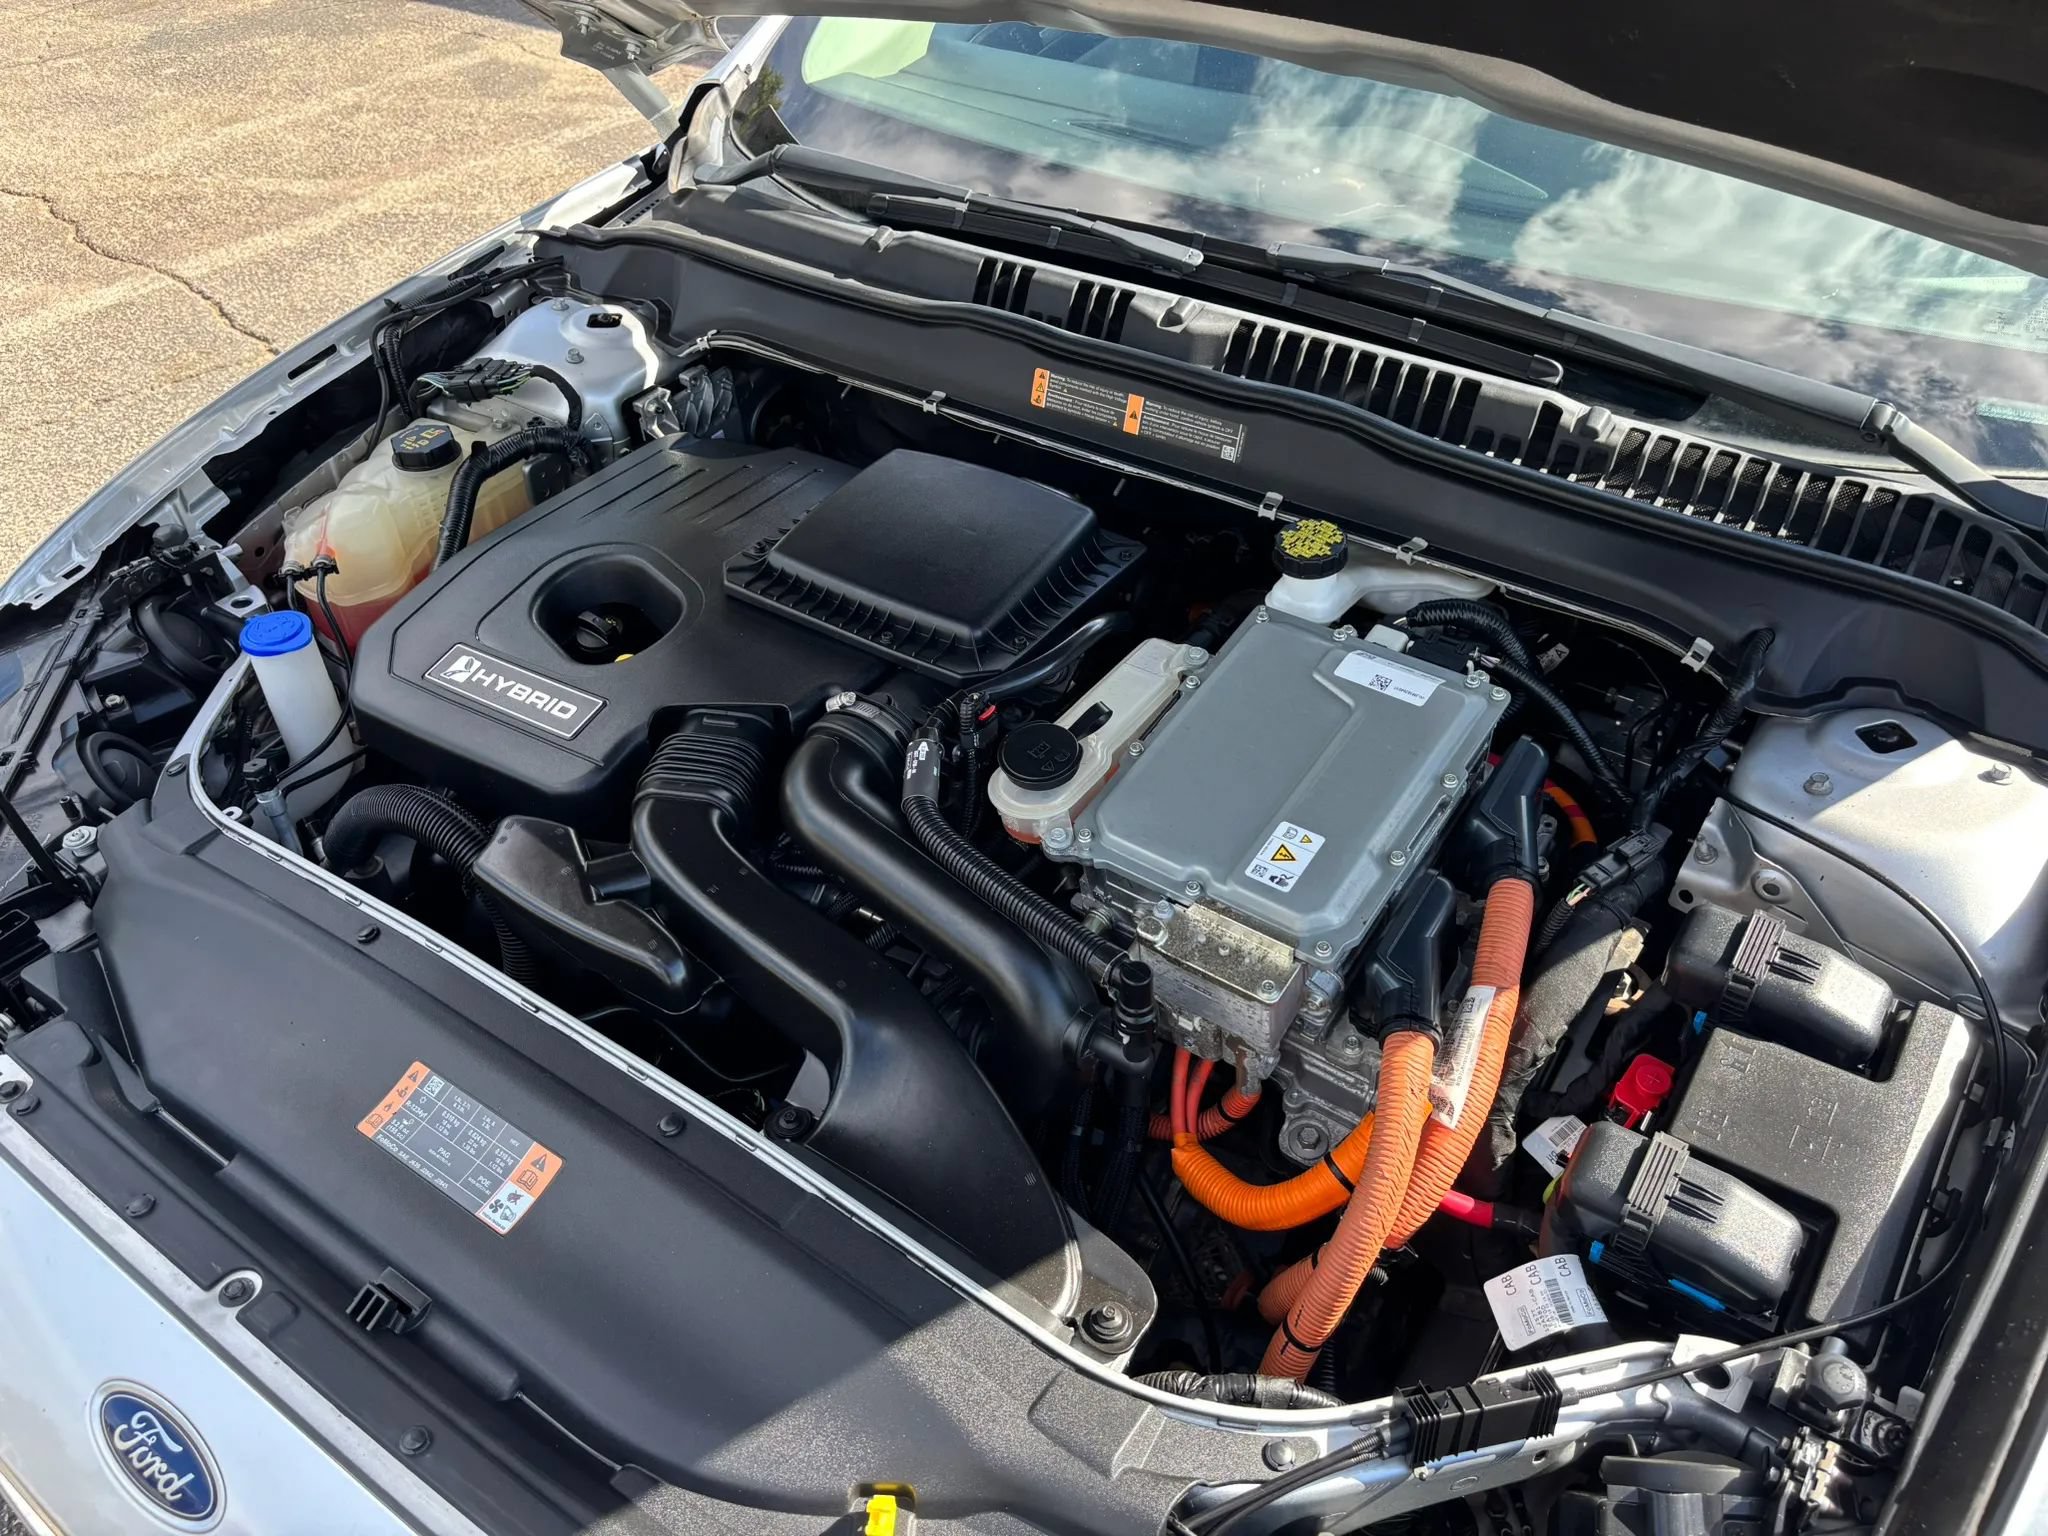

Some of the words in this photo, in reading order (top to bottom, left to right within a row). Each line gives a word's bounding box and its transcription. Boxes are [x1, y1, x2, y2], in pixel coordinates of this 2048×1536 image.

[471, 668, 578, 720] HYBRID
[405, 1100, 428, 1118] R-1234yf
[375, 1133, 399, 1152] FoMoCo
[437, 1147, 451, 1159] PAG
[477, 1175, 492, 1187] POE
[1525, 1264, 1542, 1286] CAB
[1554, 1257, 1572, 1277] CAB
[1501, 1274, 1517, 1296] CAB
[113, 1410, 195, 1500] Ford
